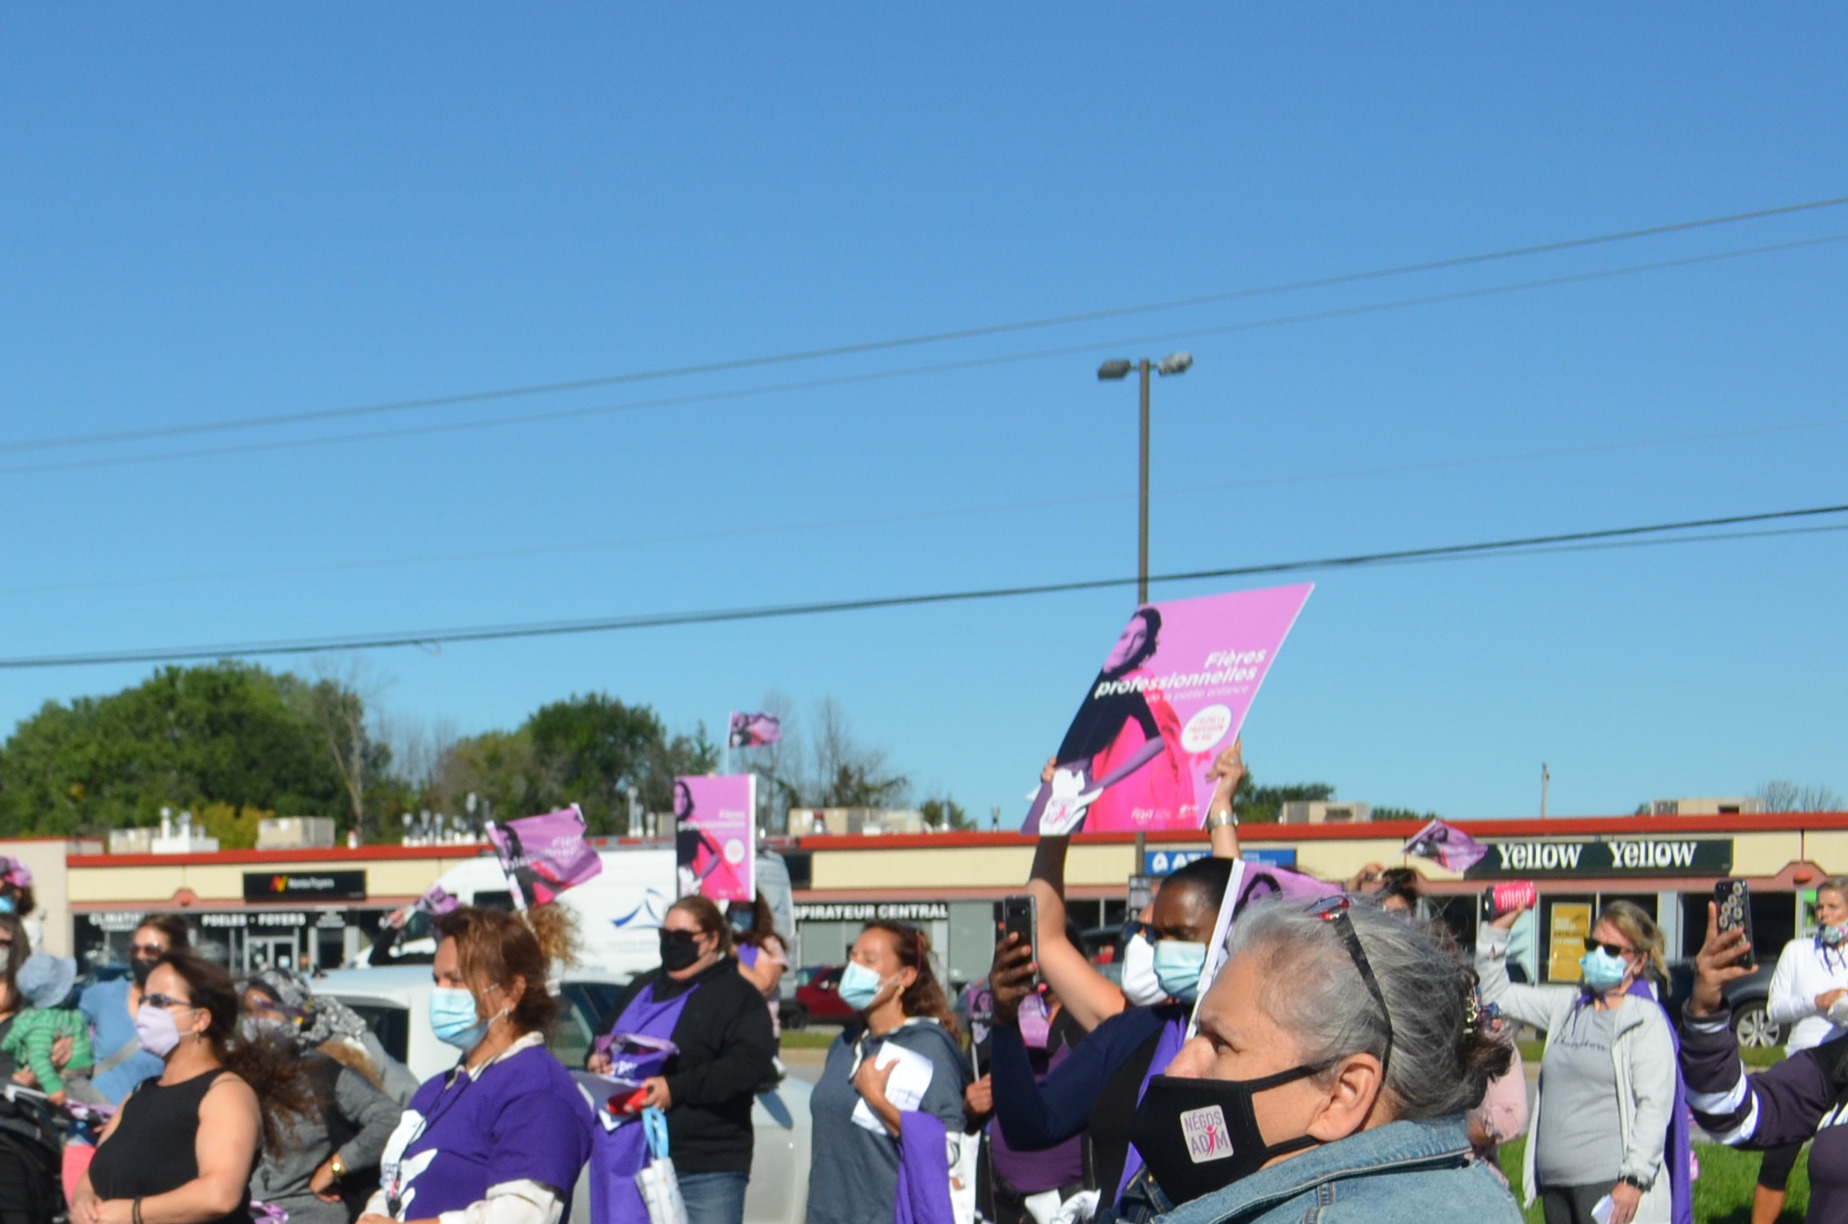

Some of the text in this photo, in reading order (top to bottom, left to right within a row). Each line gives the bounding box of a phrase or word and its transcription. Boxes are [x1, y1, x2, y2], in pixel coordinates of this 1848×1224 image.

[1204, 648, 1267, 669] Fières
[1094, 667, 1257, 699] professionnelles
[1498, 841, 1697, 870] Yellow Yellow
[793, 903, 948, 919] SPIRATEUR CENTRAL
[1184, 1111, 1223, 1132] NÉGOS
